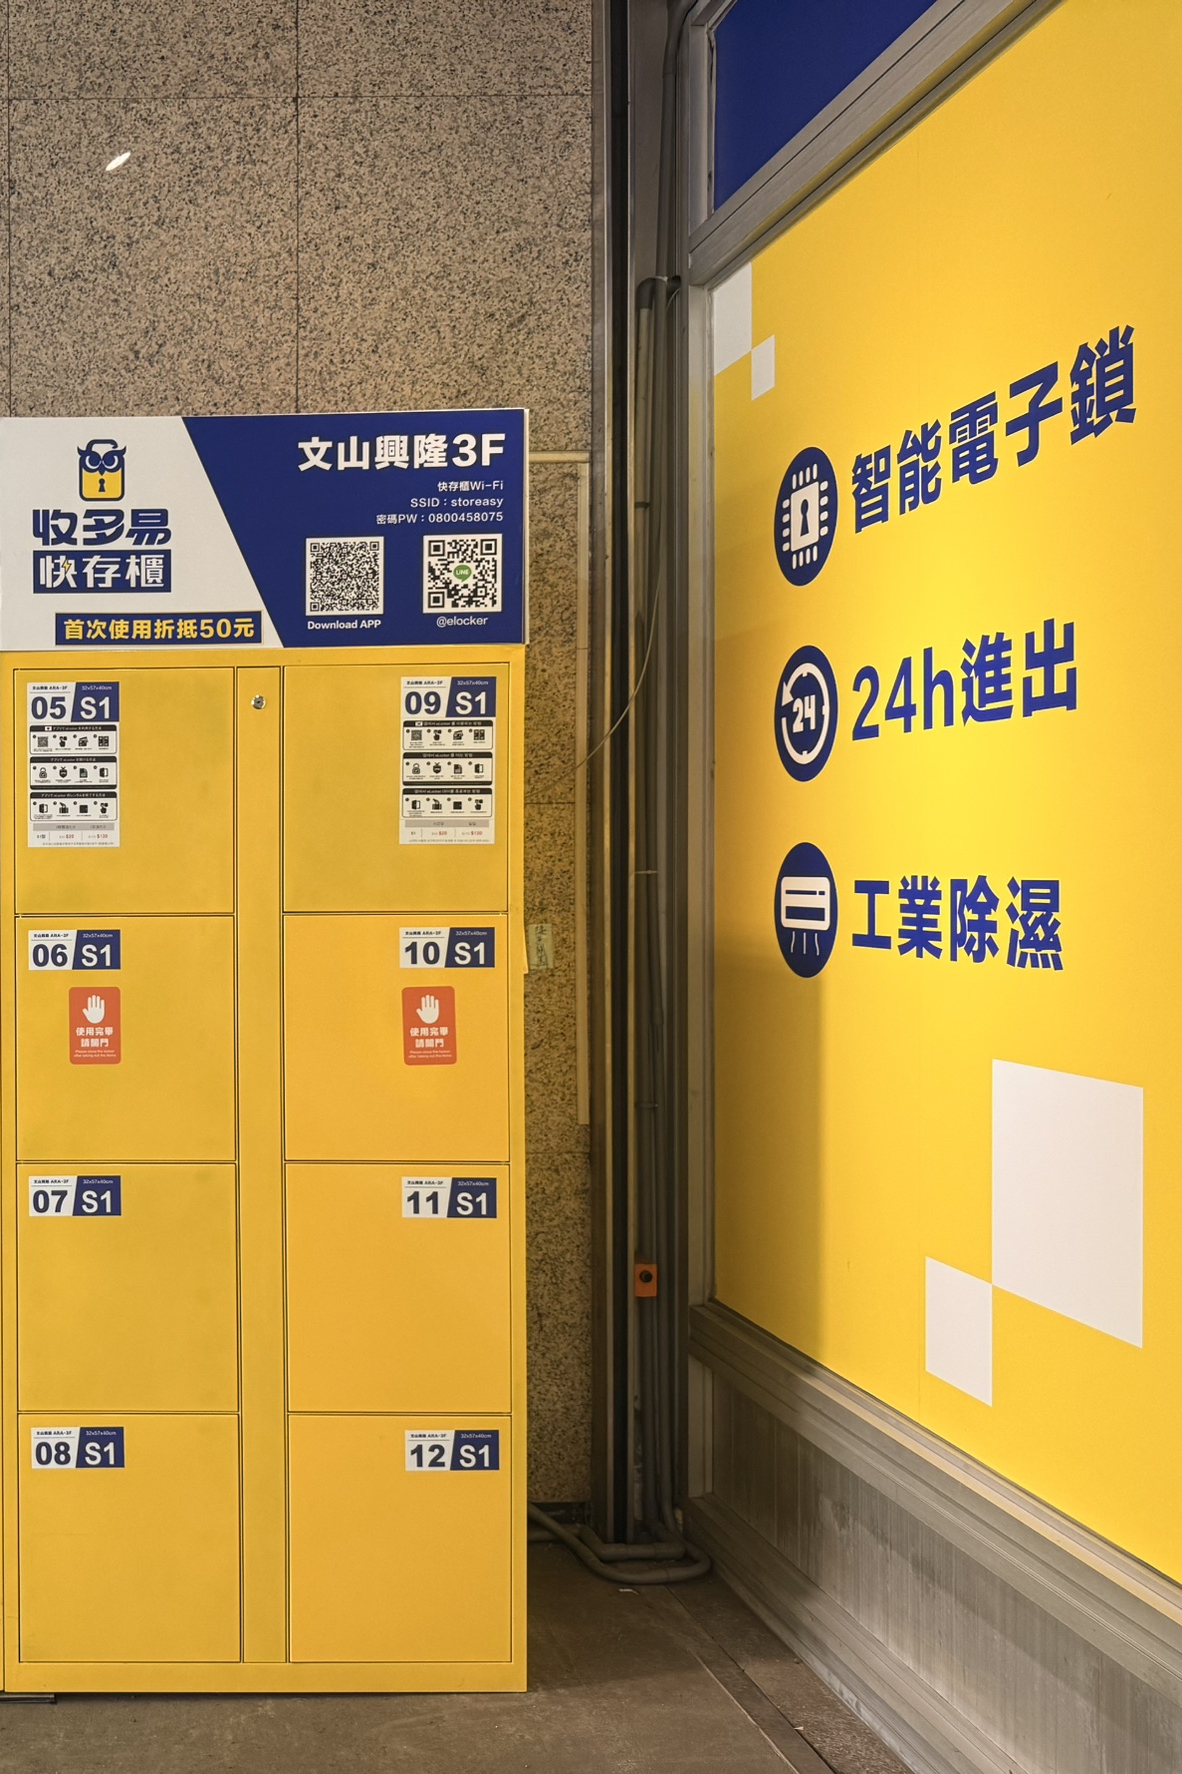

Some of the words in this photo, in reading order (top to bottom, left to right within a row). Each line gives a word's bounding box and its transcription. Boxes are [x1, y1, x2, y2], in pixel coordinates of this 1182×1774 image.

[851, 325, 1136, 533] 智能電子鎖
[298, 433, 506, 472] 文山興隆3F
[33, 508, 172, 546] 收多易
[39, 555, 165, 590] 快存櫃
[63, 618, 256, 641] 首次使用折抵50元
[307, 620, 358, 630] Download
[359, 619, 381, 628] APP
[436, 616, 488, 628] @elocker
[851, 618, 1078, 741] 24h進出
[31, 696, 66, 719] 05
[80, 696, 110, 719] S1
[405, 691, 441, 715] 09
[455, 691, 486, 714] S1
[792, 700, 818, 732] 24
[851, 874, 1064, 971] 工業除濕
[32, 944, 68, 967] 06
[82, 944, 111, 967] S1
[405, 942, 440, 965] 10
[454, 942, 484, 965] S1
[33, 1190, 68, 1213] 07
[82, 1190, 112, 1213] S1
[407, 1191, 438, 1214] 11
[456, 1192, 487, 1215] S1
[35, 1442, 71, 1465] 08
[85, 1442, 115, 1465] S1
[410, 1444, 445, 1467] 12
[459, 1444, 490, 1468] S1
